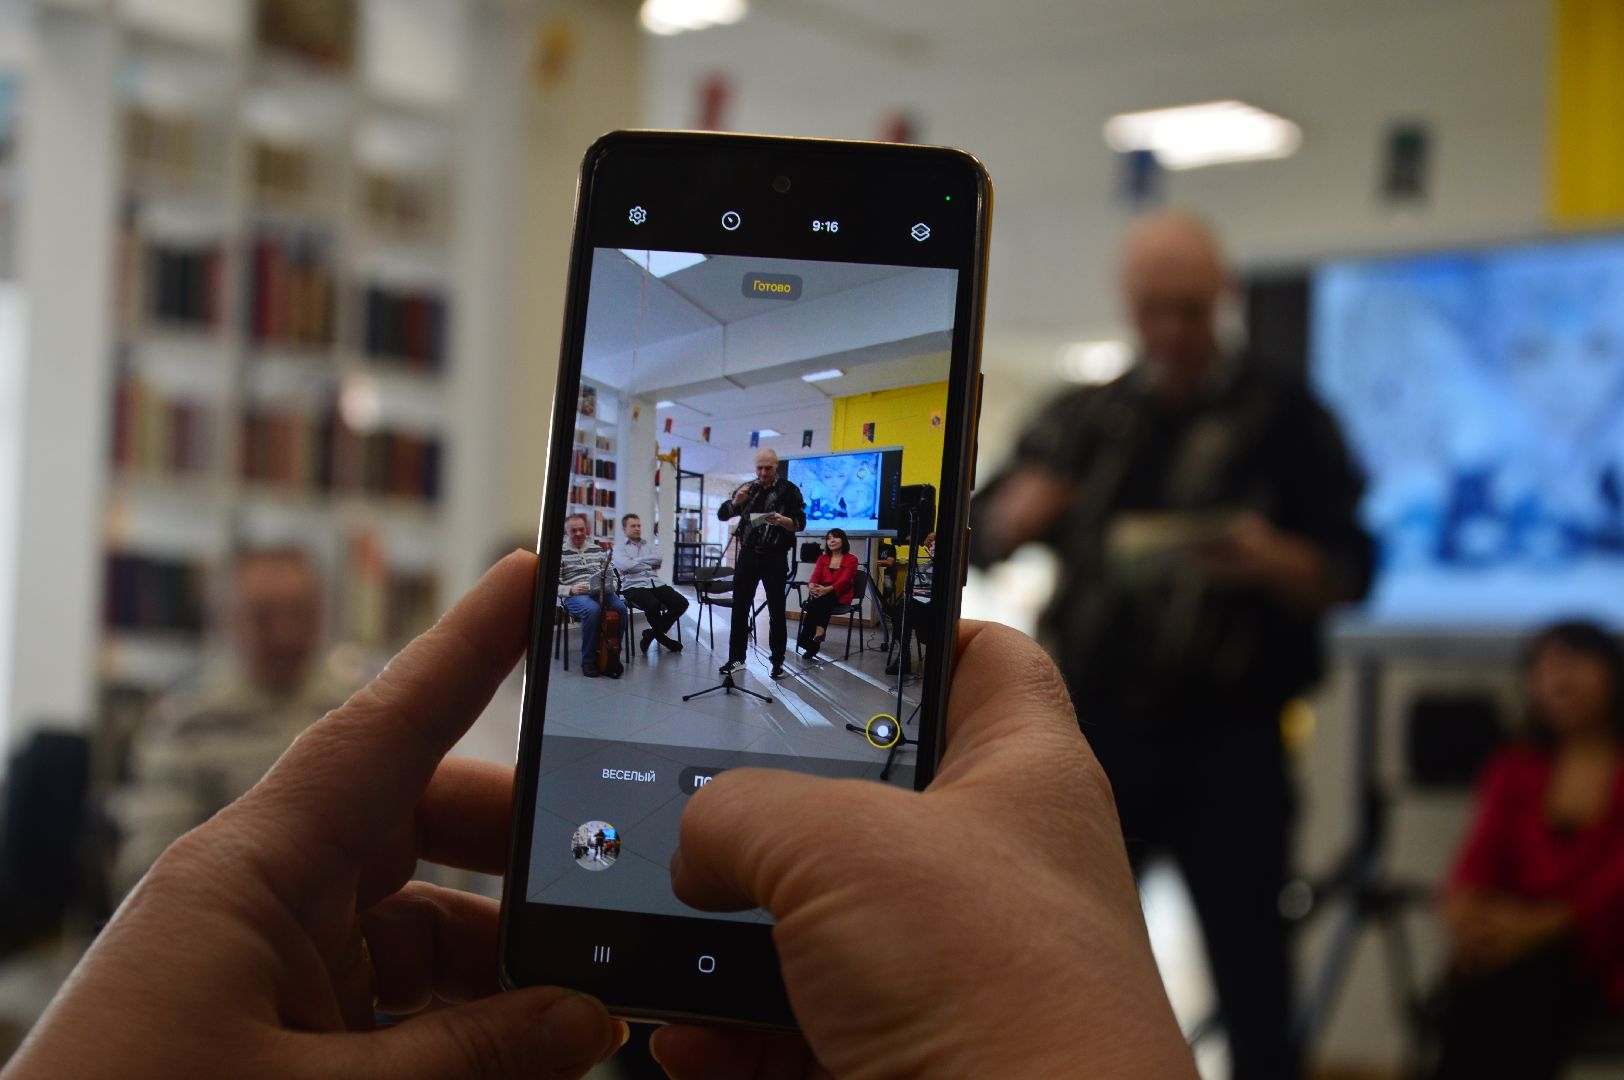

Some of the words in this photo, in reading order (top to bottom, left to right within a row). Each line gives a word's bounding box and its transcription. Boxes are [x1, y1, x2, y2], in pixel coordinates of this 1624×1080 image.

[812, 219, 839, 233] 9:16
[753, 280, 791, 293] Готово
[602, 768, 656, 782] ВЕСЕЛЫЙ
